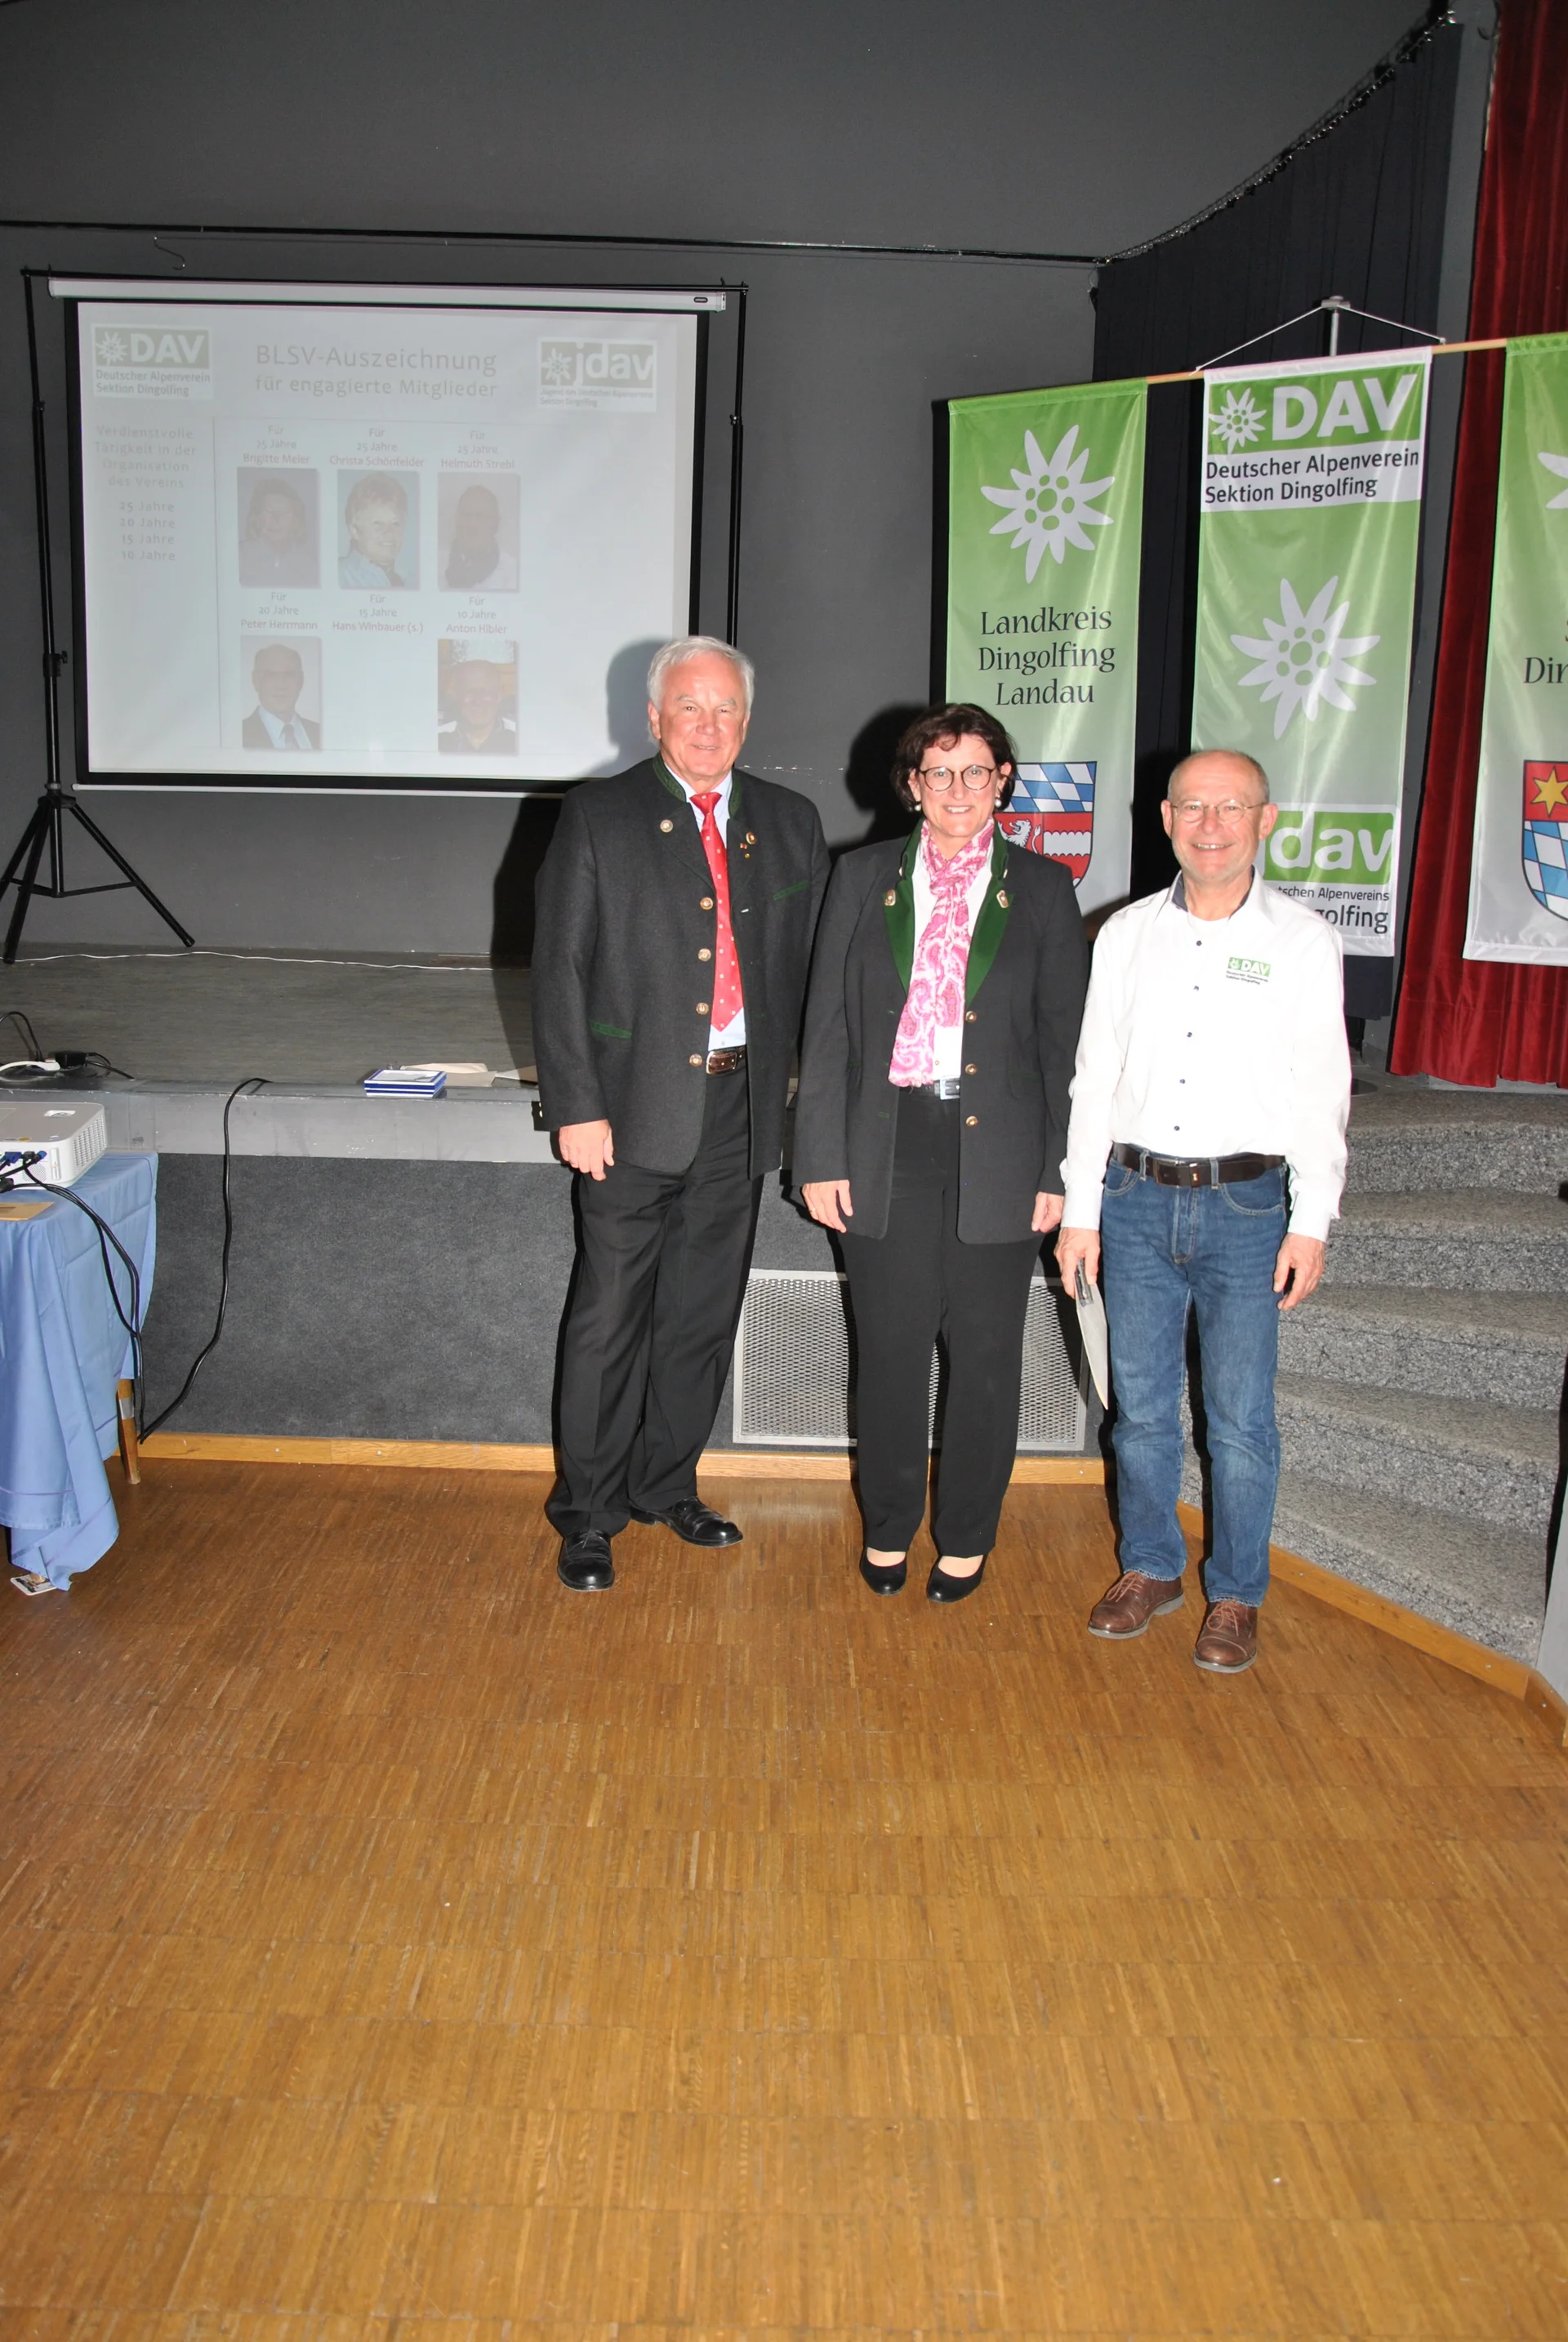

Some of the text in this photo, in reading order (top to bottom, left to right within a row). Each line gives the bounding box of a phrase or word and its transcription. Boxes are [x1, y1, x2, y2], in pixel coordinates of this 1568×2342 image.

[131, 333, 205, 363] DAV
[257, 345, 497, 376] BLSV-Auszeichnung
[573, 342, 653, 388] jdav
[96, 369, 210, 384] Deutscher Alpenverein
[96, 382, 189, 398] Sektion Dingolfing
[256, 376, 498, 400] für engagierte Mitglieder
[1272, 373, 1418, 441] DAV
[95, 425, 194, 439] Verdienstvolle
[268, 424, 284, 434] Für
[368, 427, 385, 438] Für
[469, 429, 486, 440] Für
[158, 445, 170, 455] in
[175, 443, 197, 456] der
[256, 439, 296, 451] 25 Jahre
[356, 441, 398, 452] 25 Jahre
[457, 444, 498, 455] 25 Jahre
[243, 452, 310, 465] Brigitte Meier
[329, 454, 425, 467] Christa Schönfelder
[441, 458, 514, 469] Helmuth Strebl
[1206, 447, 1419, 479] Deutscher Alpenverein
[103, 457, 189, 474] Organisation
[108, 475, 185, 488] des Vereins
[1205, 477, 1379, 504] Sektion Dingolfing
[119, 500, 175, 513] 25 Jahre
[119, 516, 176, 528] 20 Jahre
[122, 532, 175, 545] 15 Jahre
[121, 549, 176, 561] 10 Jahre
[270, 591, 287, 602] Für
[369, 594, 385, 604] Für
[469, 594, 486, 605] Für
[258, 606, 300, 616] 20 Jahre
[359, 608, 398, 618] 15 Jahre
[457, 608, 497, 619] 10 Jahre
[240, 619, 318, 630] Peter Herrmann
[981, 606, 1111, 634] Landkreis
[332, 621, 424, 634] Hans Winbauer (s.)
[446, 623, 507, 634] Anton Hibler
[978, 641, 1116, 676] Dingolfing
[996, 678, 1094, 706] Landau
[1318, 888, 1389, 901] Alpenvereins
[1315, 905, 1388, 934] olfing
[1241, 960, 1271, 976] DAV
